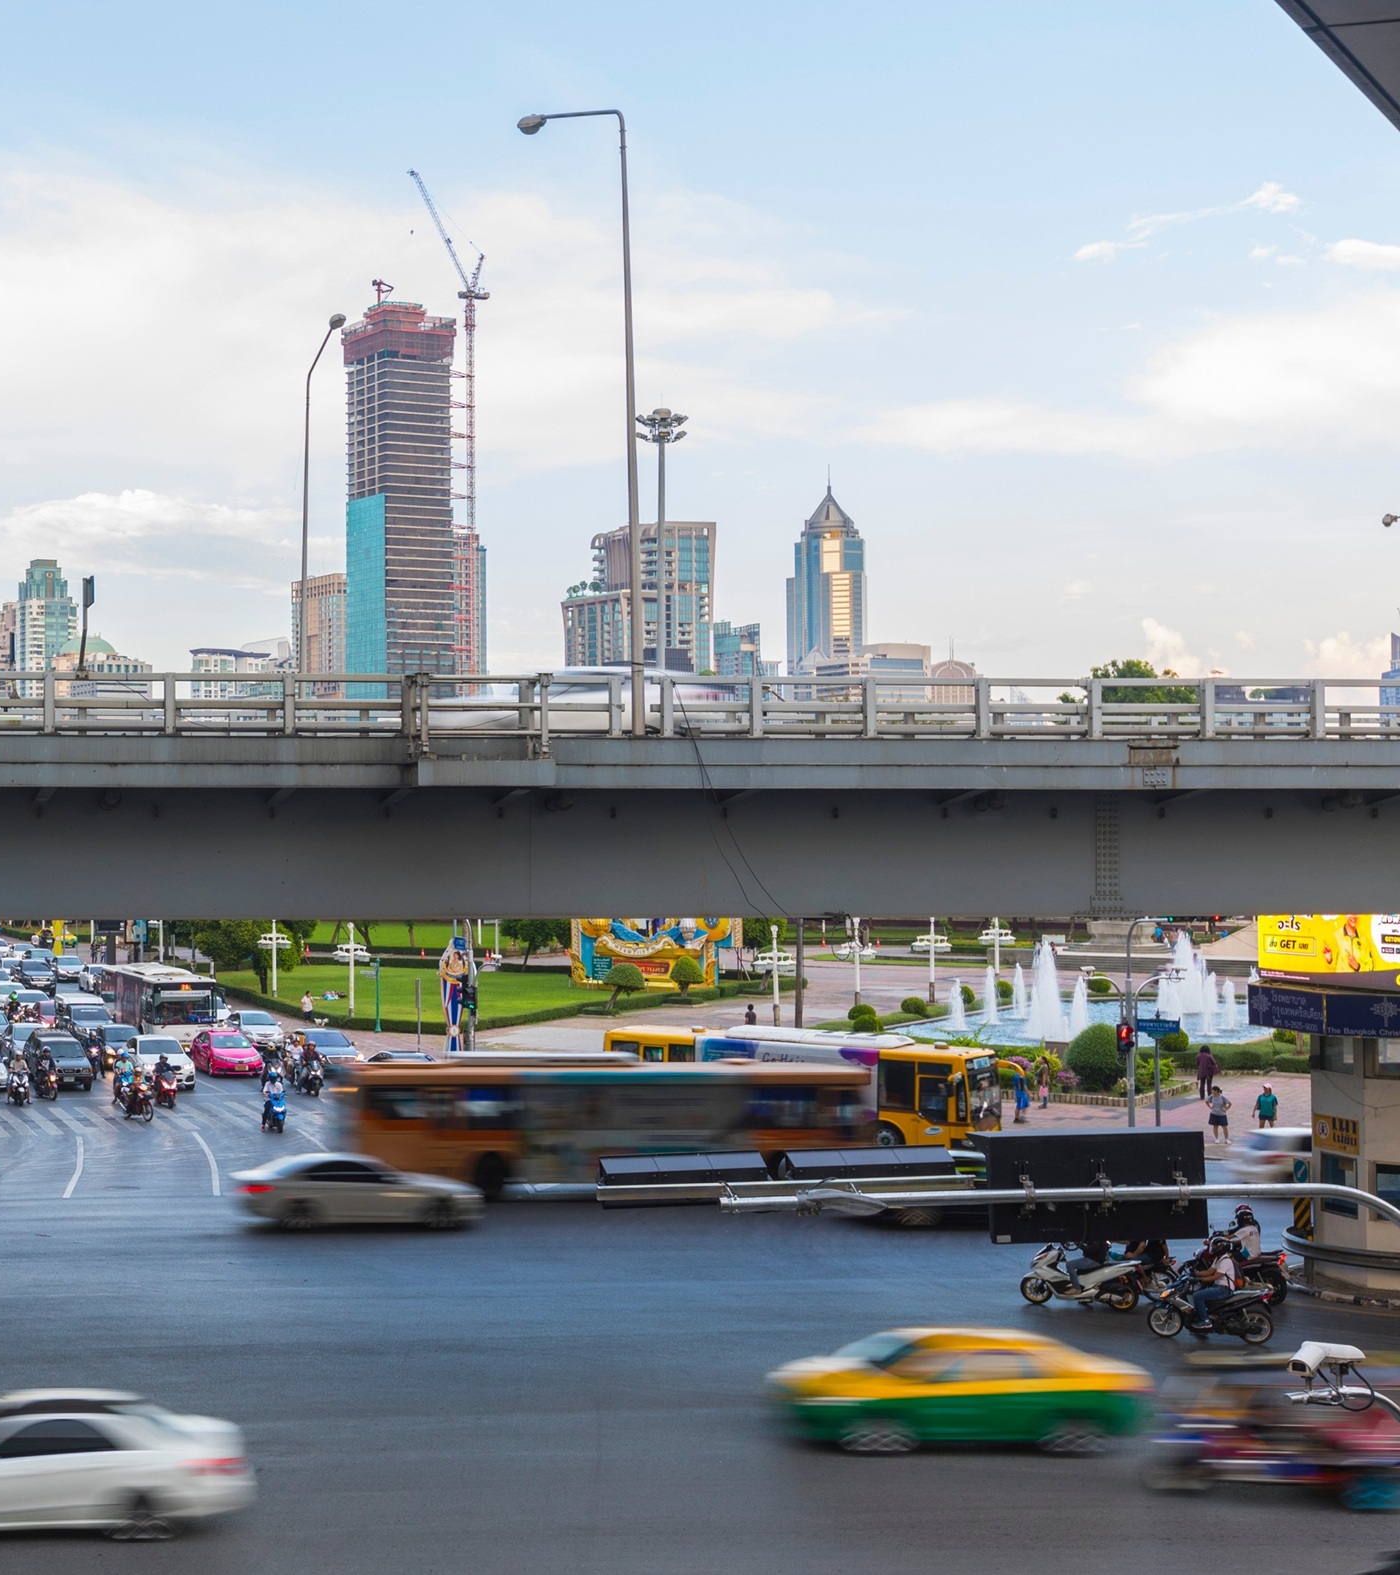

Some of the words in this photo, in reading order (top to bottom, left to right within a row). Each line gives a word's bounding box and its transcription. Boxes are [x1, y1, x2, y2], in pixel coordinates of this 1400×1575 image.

[1280, 939, 1297, 950] GET
[1271, 989, 1307, 1006] โรงพยาบาล
[1327, 1026, 1341, 1034] The
[1343, 1027, 1377, 1036] Bangkok
[1379, 1028, 1400, 1036] Chris
